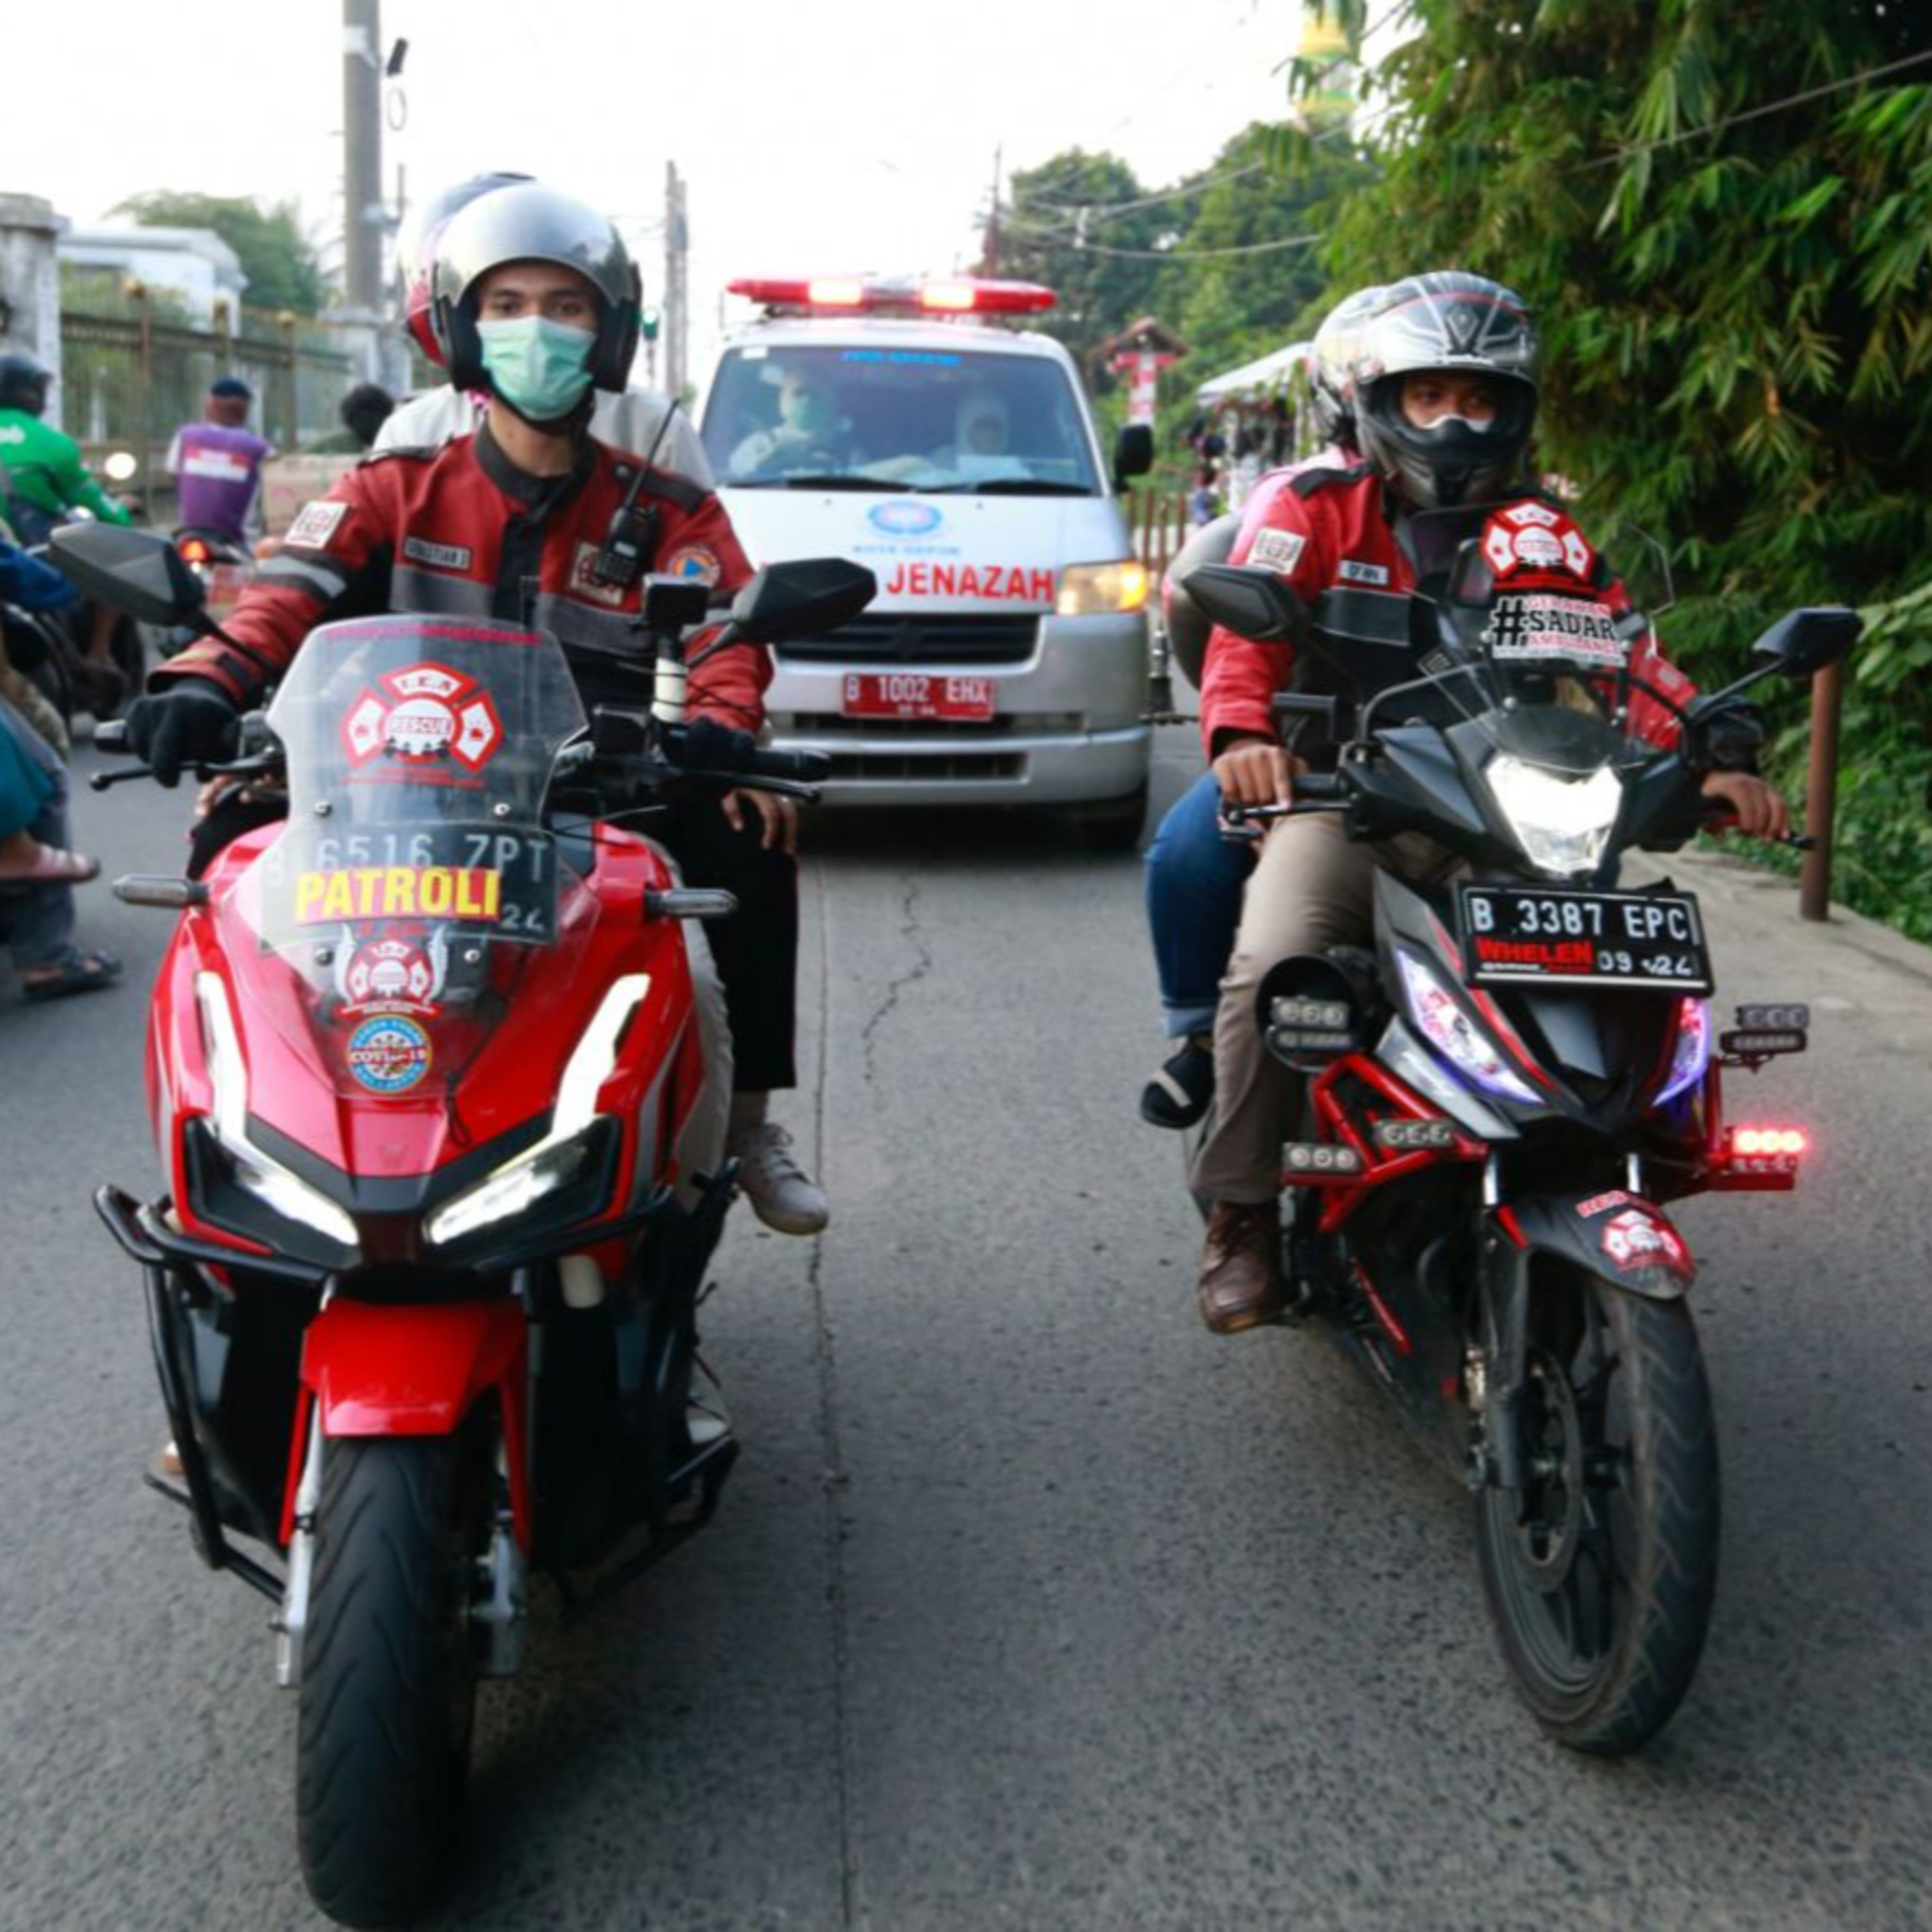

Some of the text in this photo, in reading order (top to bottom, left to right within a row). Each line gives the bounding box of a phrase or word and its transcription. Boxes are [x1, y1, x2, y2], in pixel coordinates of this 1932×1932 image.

[886, 562, 1054, 603] JENAZAH
[846, 677, 860, 702] B
[878, 676, 930, 703] 1002
[316, 836, 434, 869] 6516
[296, 867, 500, 920] PATROLI
[1470, 898, 1688, 941] B 3387 EPC
[1474, 936, 1595, 963] WHELEN
